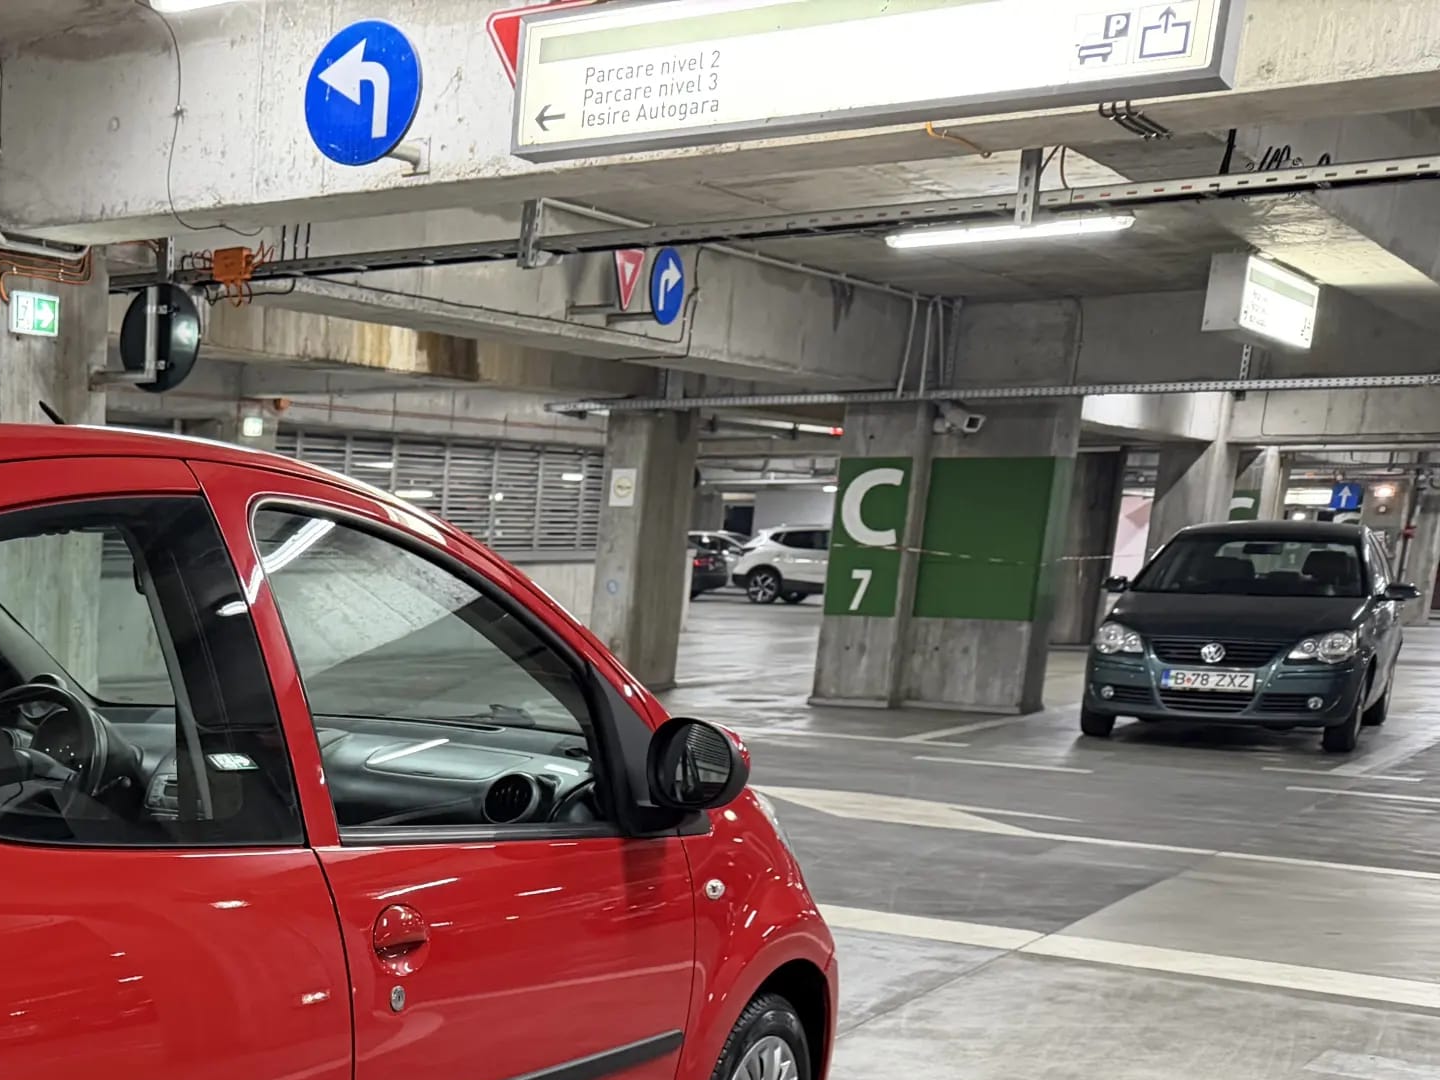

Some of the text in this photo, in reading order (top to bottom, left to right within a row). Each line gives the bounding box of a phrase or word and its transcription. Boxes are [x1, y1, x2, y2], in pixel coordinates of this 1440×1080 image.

[585, 50, 720, 85] Parcare nivel 2
[583, 72, 718, 107] Parcare nivel 3
[581, 99, 719, 128] Iesire Autogara
[841, 467, 905, 546] C
[848, 568, 873, 611] 7
[1174, 671, 1250, 688] B 78 ZXZ
